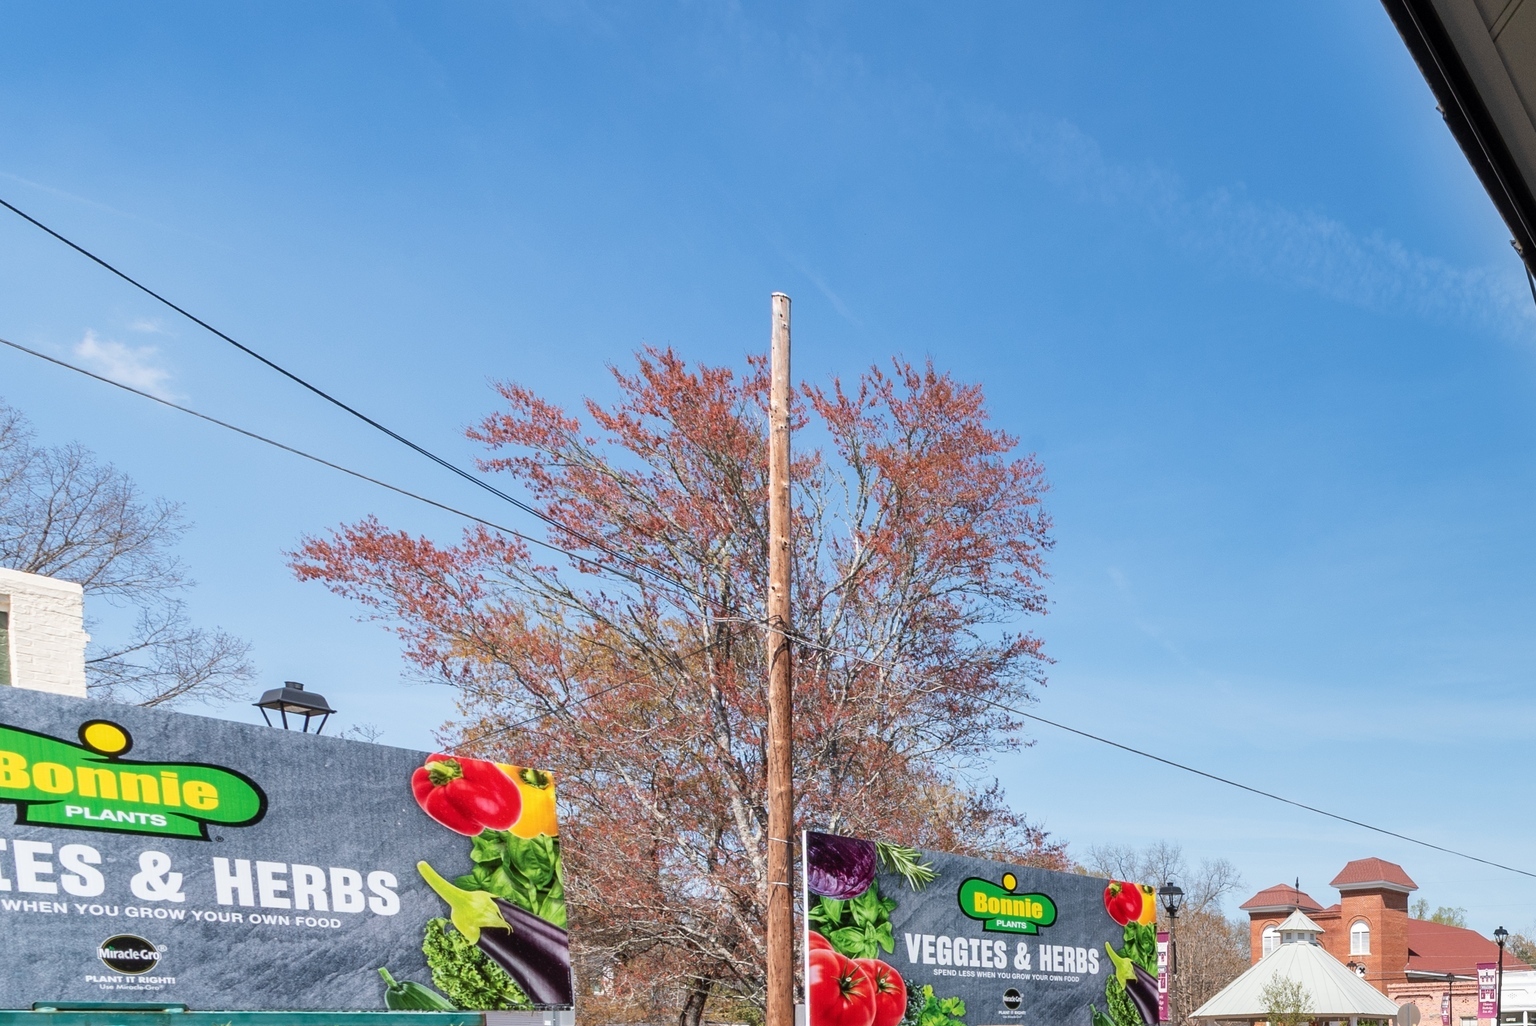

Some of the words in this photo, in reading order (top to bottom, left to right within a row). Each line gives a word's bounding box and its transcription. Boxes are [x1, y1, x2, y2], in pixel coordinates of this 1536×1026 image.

[0, 751, 219, 810] Bonnie
[65, 805, 168, 827] PLANTS
[131, 850, 185, 902] &
[213, 856, 401, 917] HERBS
[3, 900, 68, 914] WHEN
[74, 904, 119, 917] YOU
[128, 906, 186, 920] GROW
[192, 910, 244, 924] YOUR
[249, 914, 290, 926] OWN
[295, 917, 342, 929] FOOD
[973, 891, 1043, 919] Bonnie
[996, 920, 1027, 929] PLANTS
[98, 947, 160, 961] Miracle-Gro
[904, 933, 1008, 970] VEGGIES
[1014, 942, 1031, 970] &
[1039, 944, 1100, 975] HERBS
[85, 975, 123, 983] PLANT
[138, 976, 176, 985] RIGHT!
[933, 968, 957, 977] SPEND
[958, 970, 976, 978] LESS
[976, 971, 996, 979] WHEN
[1063, 975, 1080, 983] FOOD
